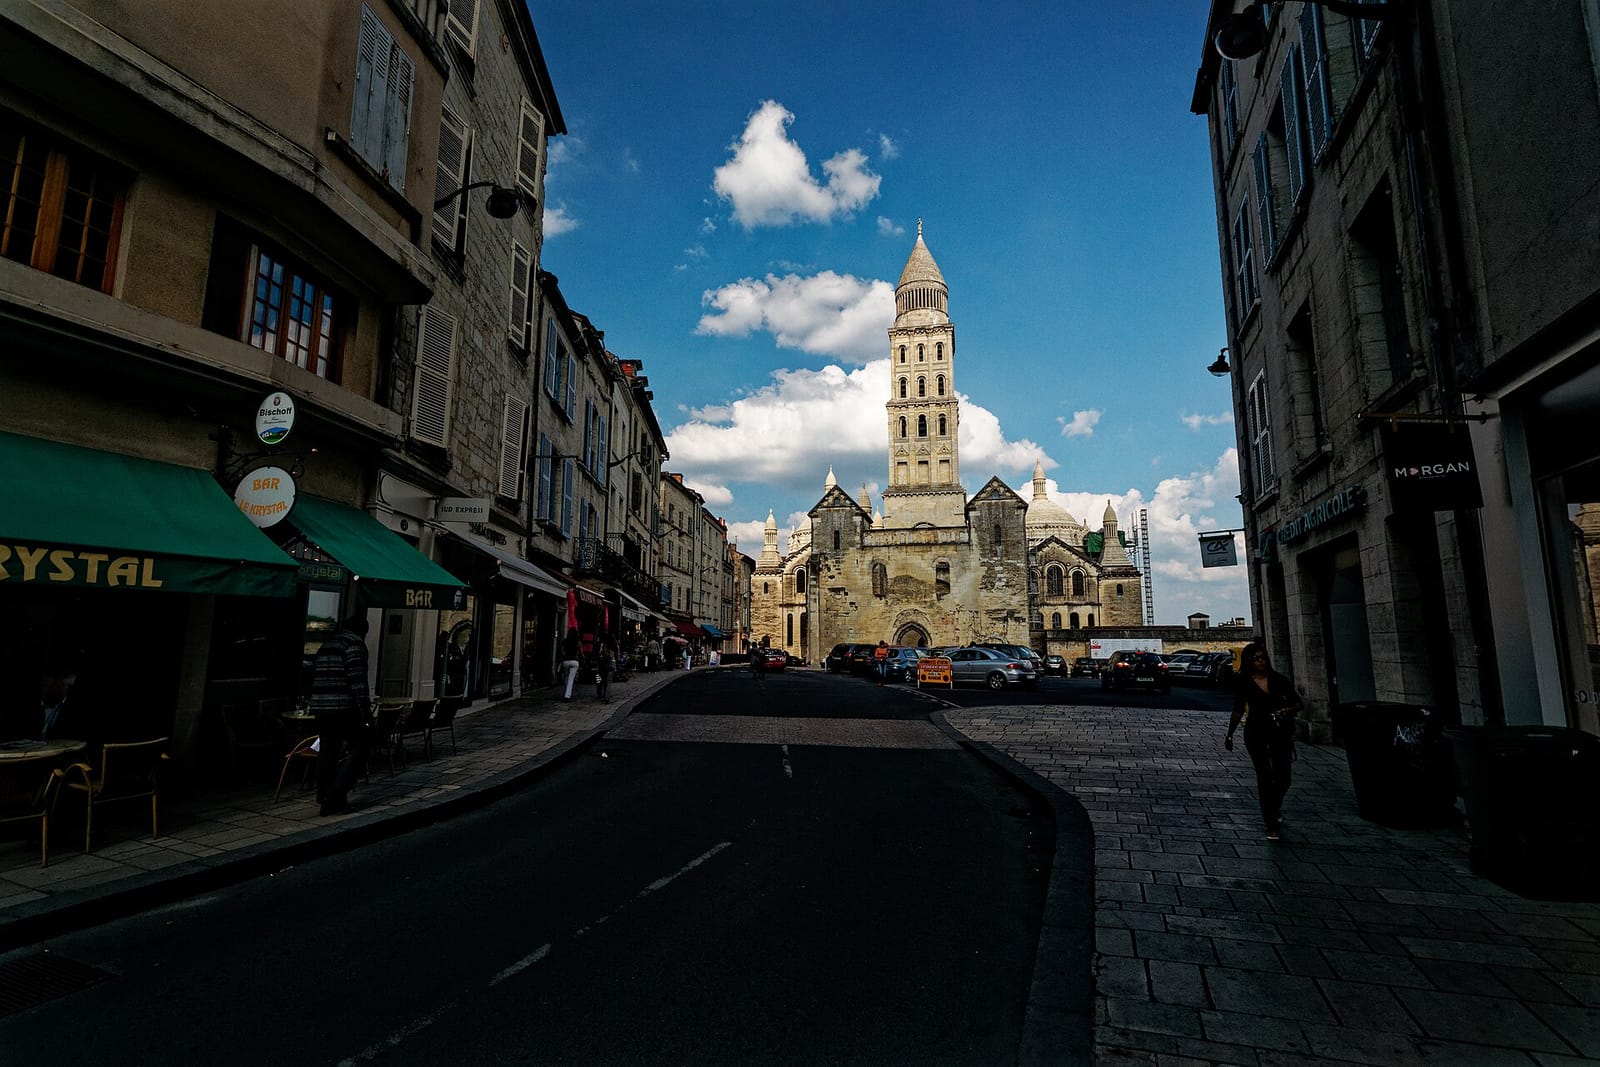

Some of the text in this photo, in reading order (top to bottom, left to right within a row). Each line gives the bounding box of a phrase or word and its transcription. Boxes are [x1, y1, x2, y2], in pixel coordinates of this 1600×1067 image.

[260, 408, 292, 417] Bischoff
[252, 478, 280, 491] BAR
[250, 500, 288, 517] KRYSTAL
[1304, 487, 1356, 531] AGRICOLE
[406, 588, 433, 607] BAR
